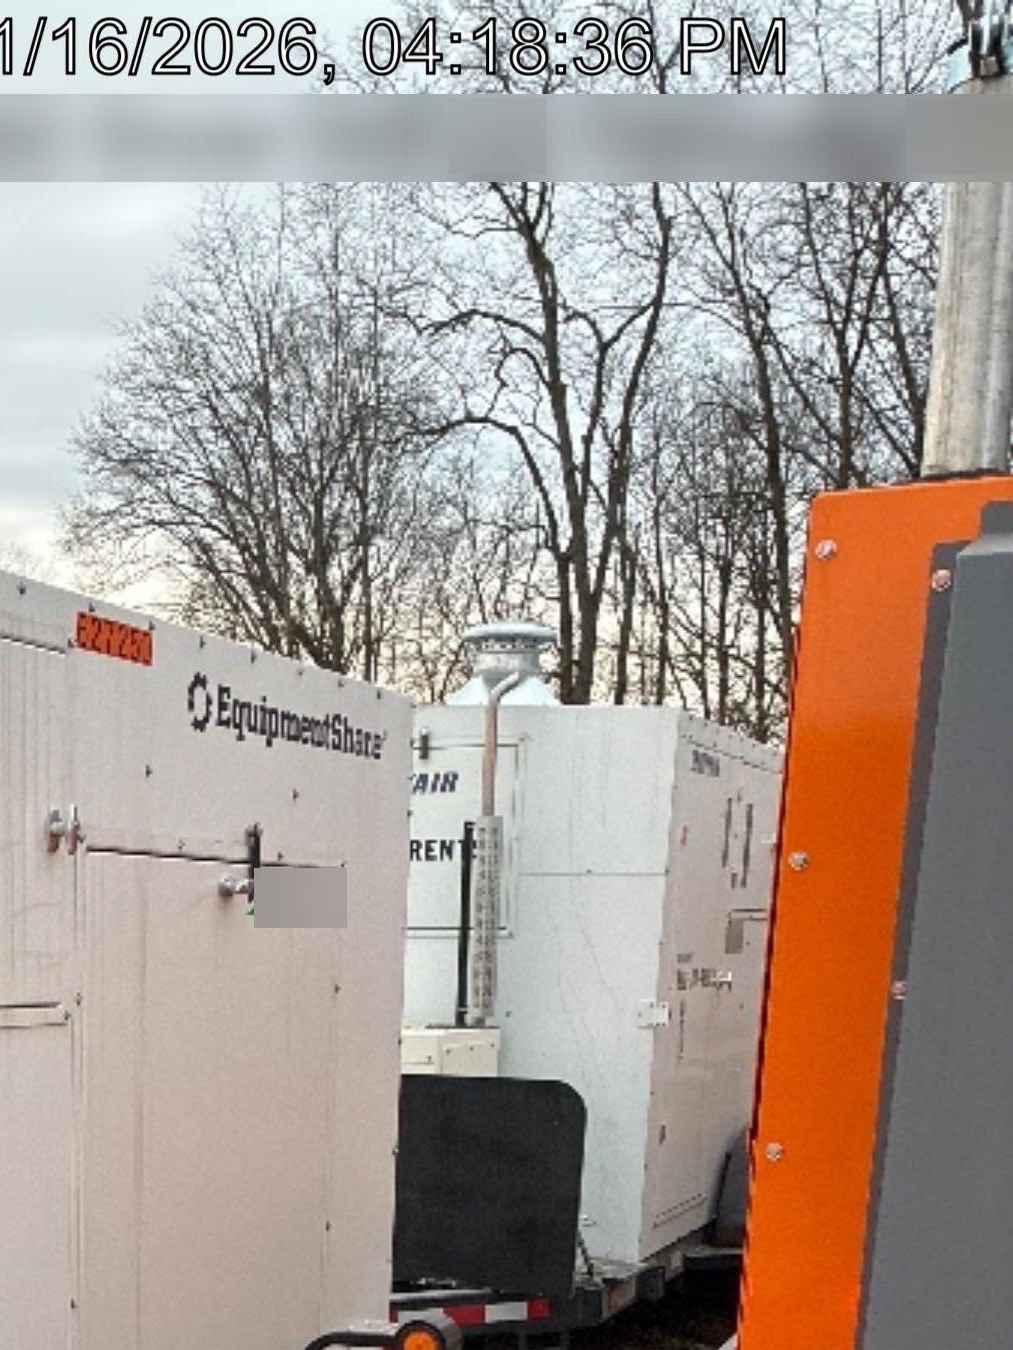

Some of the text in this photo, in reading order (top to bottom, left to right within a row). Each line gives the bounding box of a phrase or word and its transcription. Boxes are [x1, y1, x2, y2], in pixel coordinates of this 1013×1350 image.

[215, 683, 382, 760] EquipmentShare
[412, 772, 459, 794] AIR
[409, 839, 477, 862] REN
